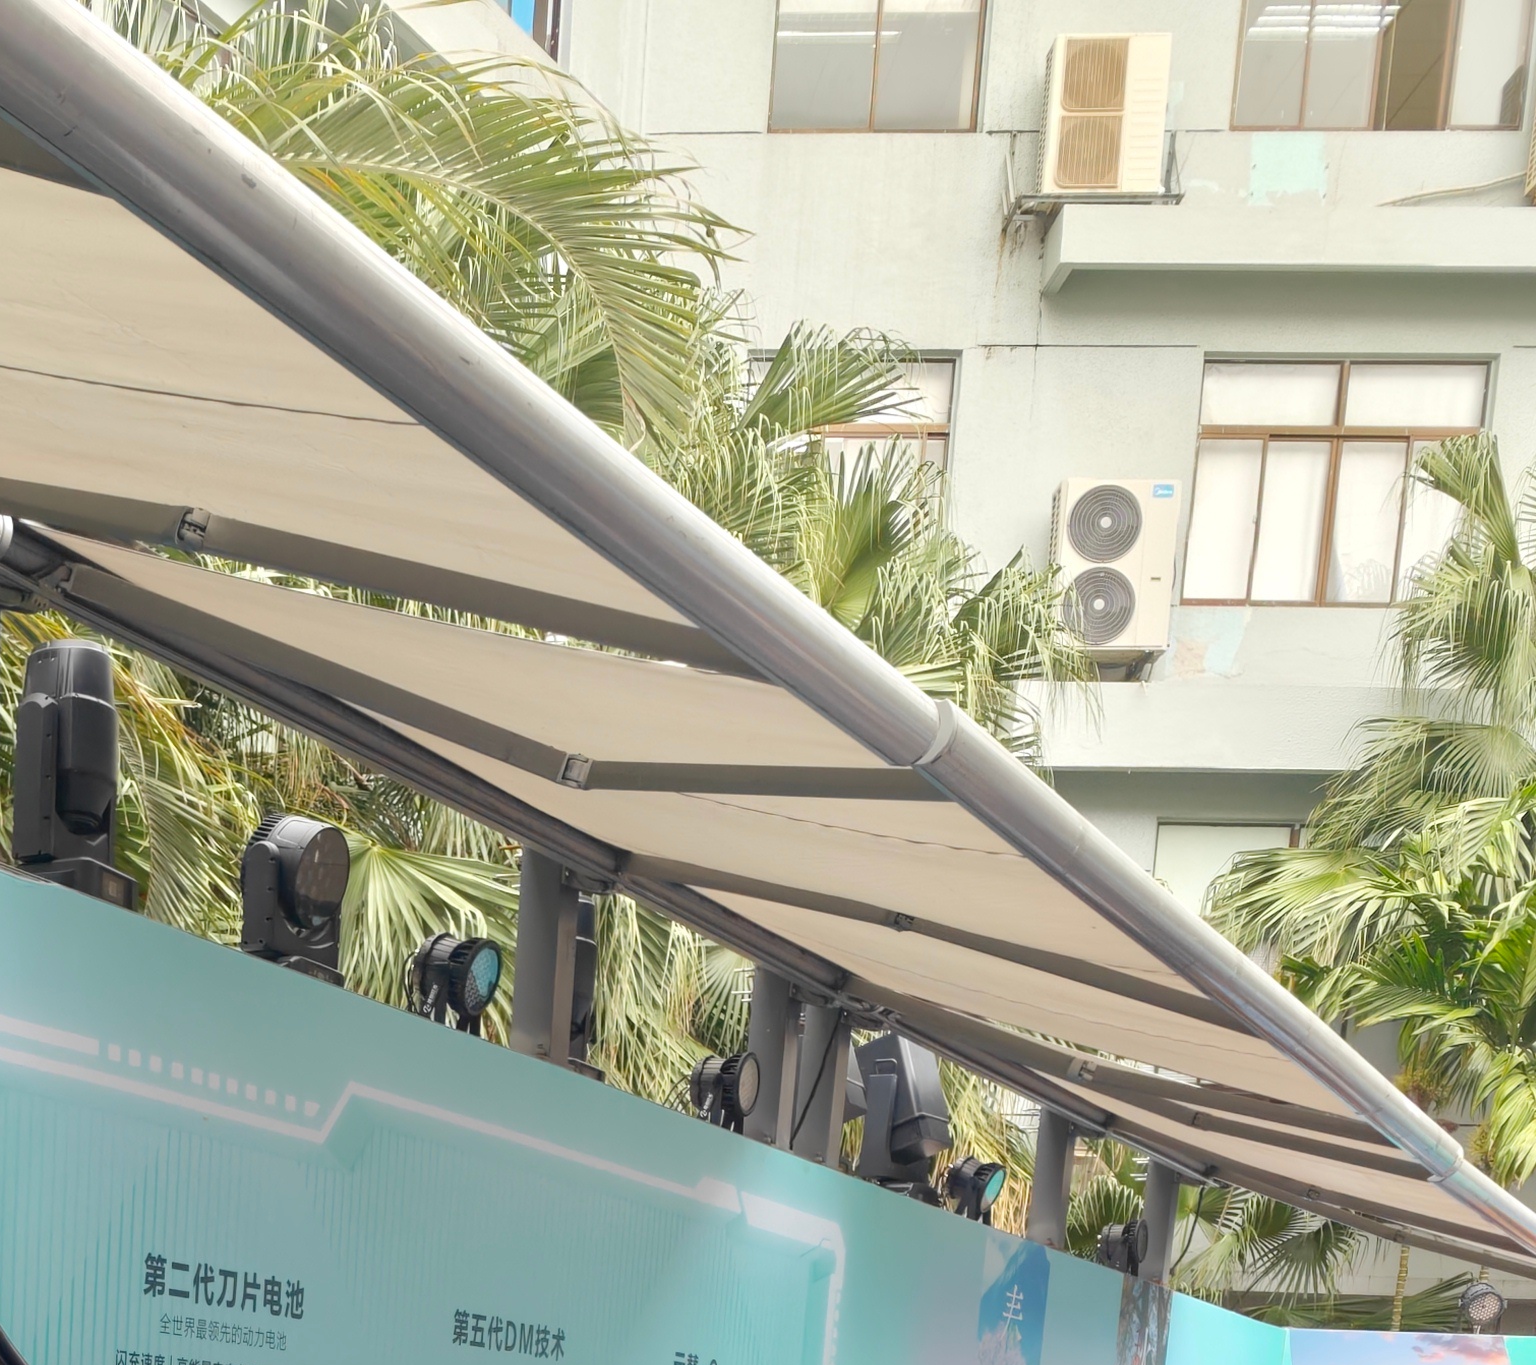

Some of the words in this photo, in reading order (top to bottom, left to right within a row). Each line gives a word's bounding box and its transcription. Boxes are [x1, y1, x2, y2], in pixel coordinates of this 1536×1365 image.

[143, 1252, 305, 1320] 第二代刀片电池
[159, 1313, 287, 1351] 全世界最领先的动力电池
[452, 1308, 566, 1361] 第五代DM技术
